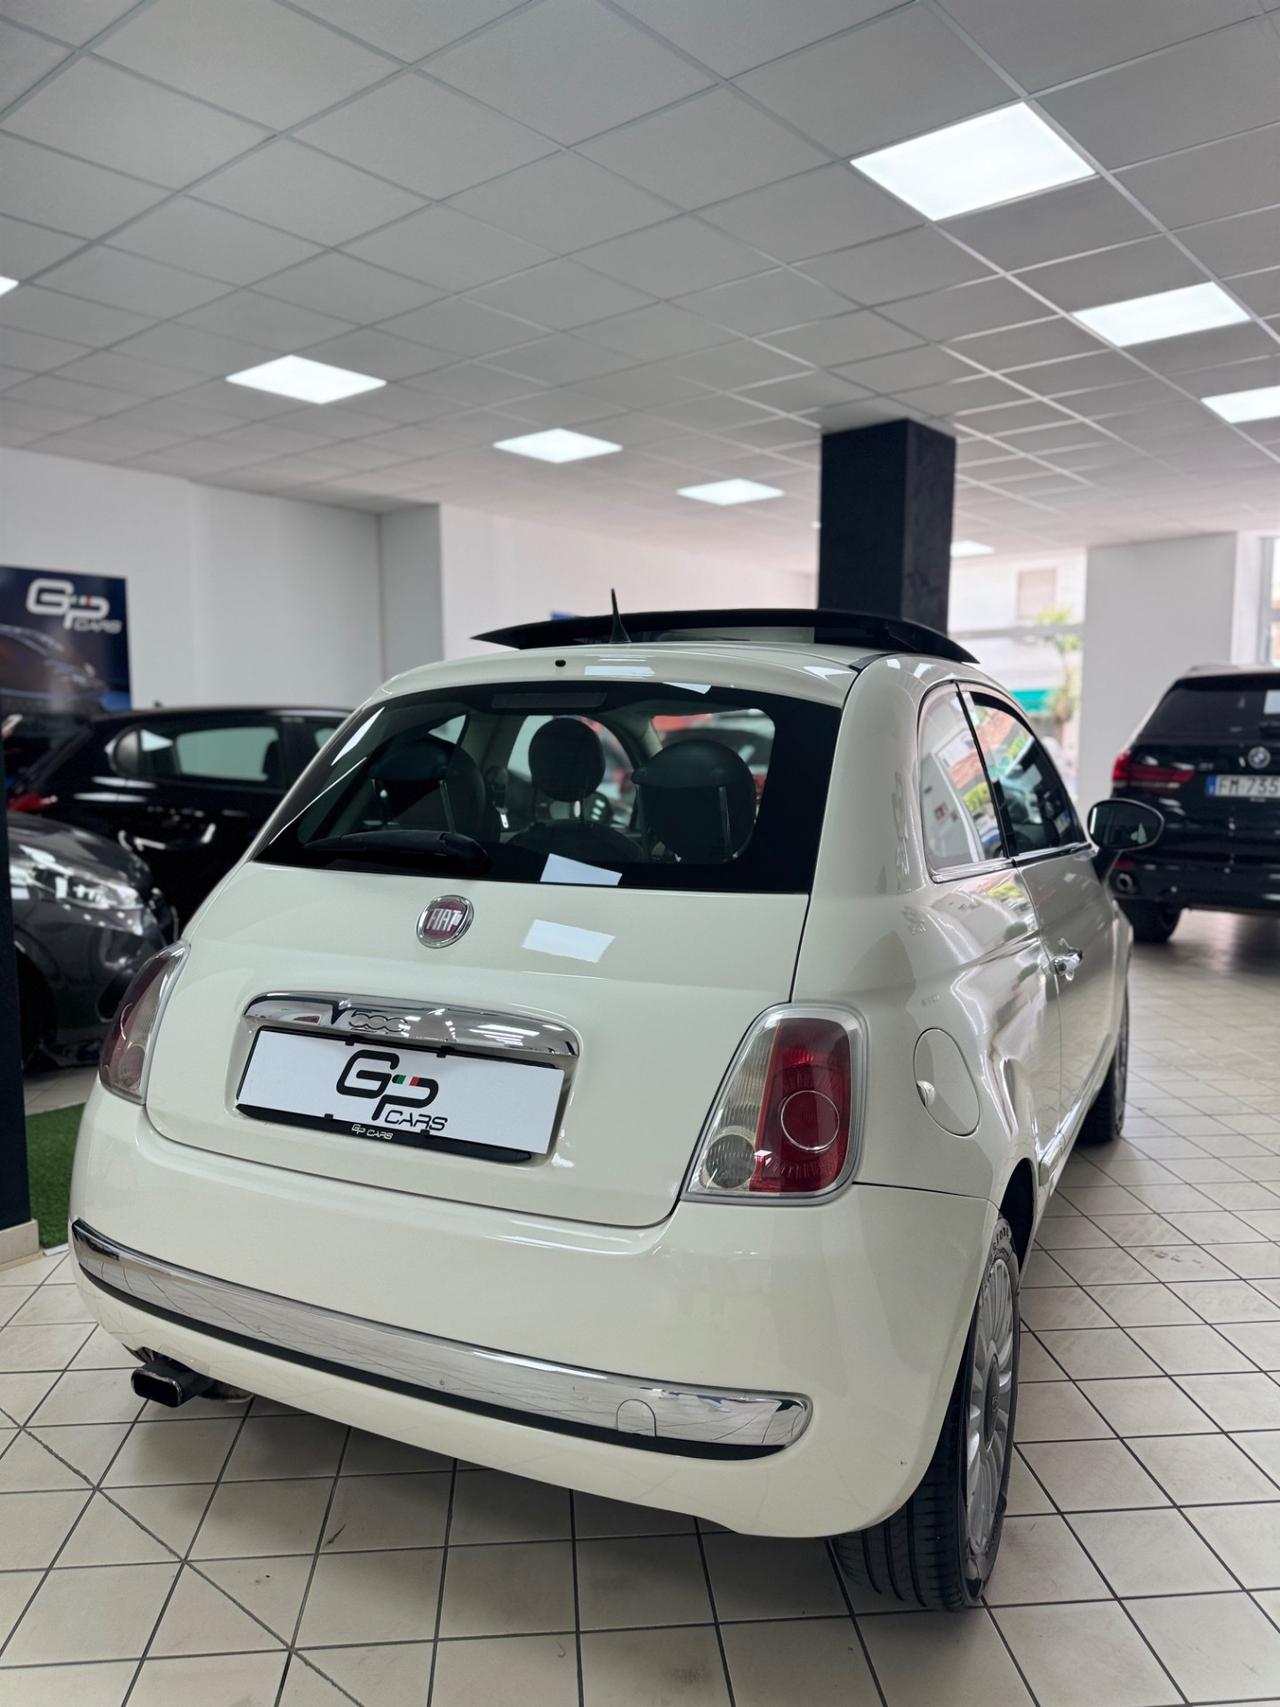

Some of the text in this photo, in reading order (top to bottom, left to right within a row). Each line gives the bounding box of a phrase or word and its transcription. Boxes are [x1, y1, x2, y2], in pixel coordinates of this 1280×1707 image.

[26, 578, 110, 630] GP
[73, 619, 122, 634] CARS
[426, 908, 462, 932] FIAT
[348, 1010, 408, 1033] 500
[336, 1049, 440, 1121] GP
[384, 1109, 448, 1131] CARS
[366, 1129, 394, 1140] CARS
